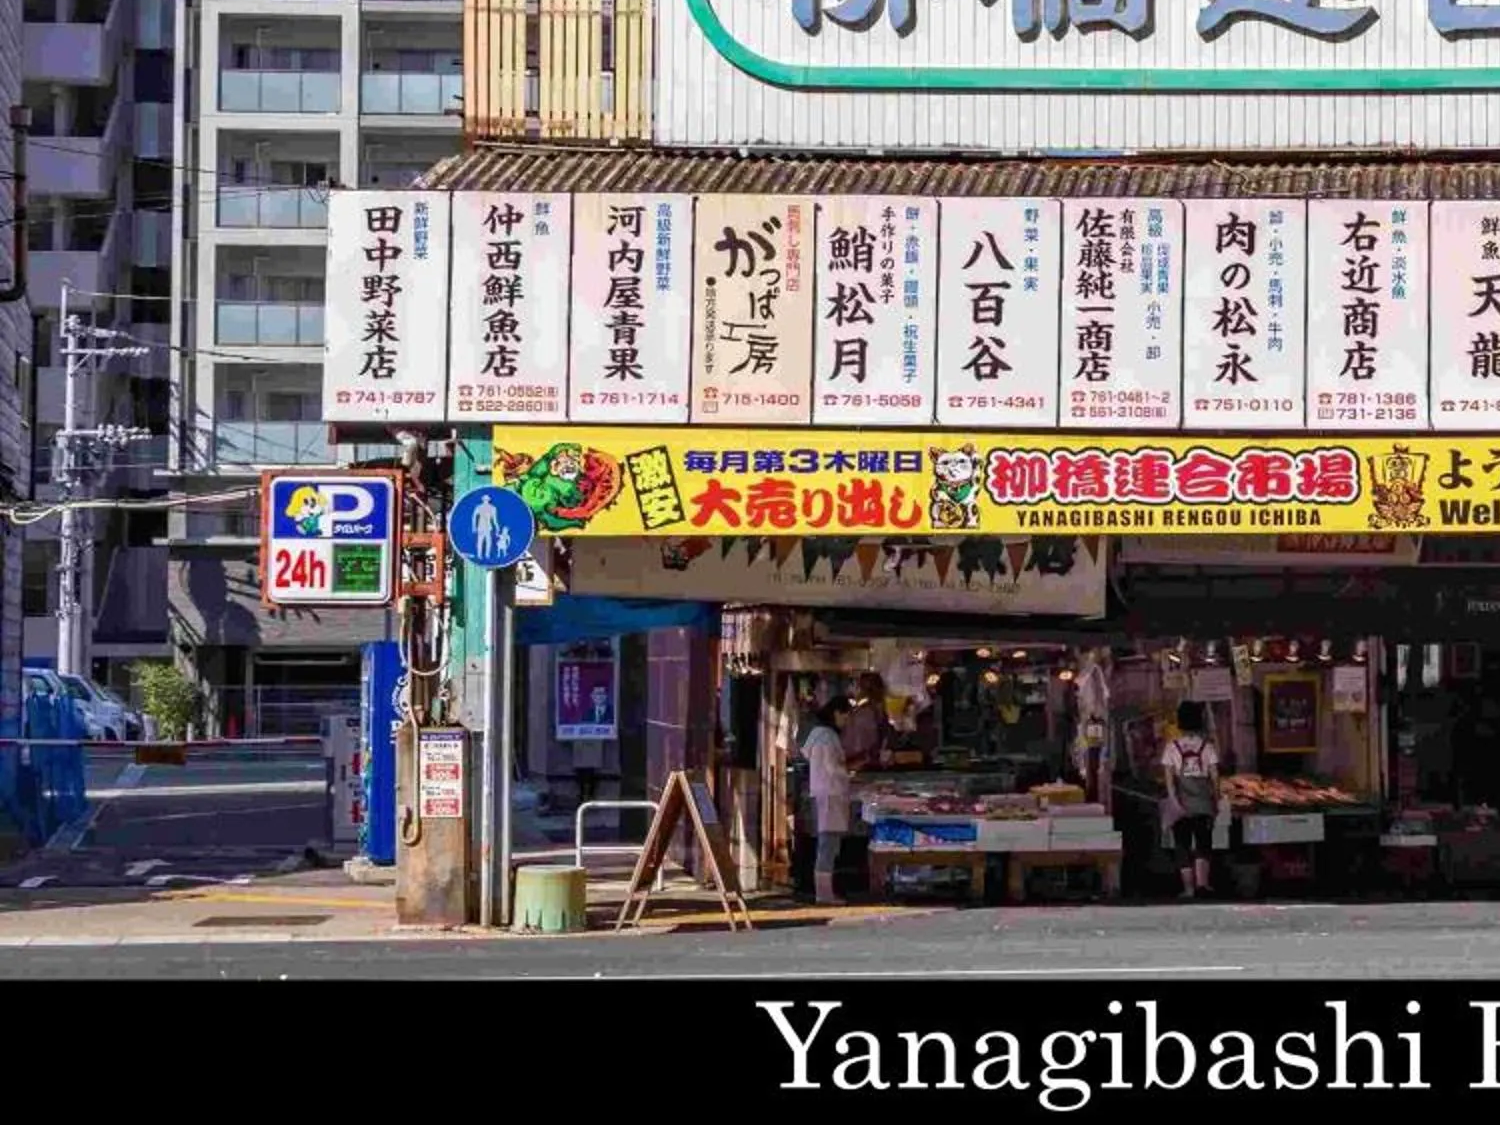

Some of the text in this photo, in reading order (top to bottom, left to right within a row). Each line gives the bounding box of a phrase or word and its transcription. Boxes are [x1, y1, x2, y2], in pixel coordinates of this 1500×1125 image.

[880, 207, 897, 305] 手作りの菓子
[1023, 208, 1039, 292] 野菜・果実
[1119, 209, 1136, 273] 有限会社
[1480, 217, 1500, 260] 鮮魚
[360, 206, 402, 380] 田中野菜店
[481, 203, 525, 378] 仲西鮮魚店
[604, 205, 646, 381] 河内屋青果
[825, 226, 877, 384] 鮹松月
[961, 231, 1015, 381] 八百谷
[1074, 208, 1116, 382] 佐藤純一商店
[1212, 212, 1258, 385] 肉の松永
[1339, 212, 1382, 381] 右近商店
[355, 391, 435, 404] 741-8787
[1212, 398, 1293, 412] 751-0110
[1335, 408, 1417, 420] 731-2136
[630, 449, 682, 527] 激安
[684, 449, 924, 474] 毎月第3木曜日
[988, 449, 1359, 501] 柳橋連合市場
[690, 478, 923, 529] 大売り出し
[1016, 508, 1322, 527] YANAGIBASHI RENGOU ICHIBA
[275, 549, 326, 589] 24h
